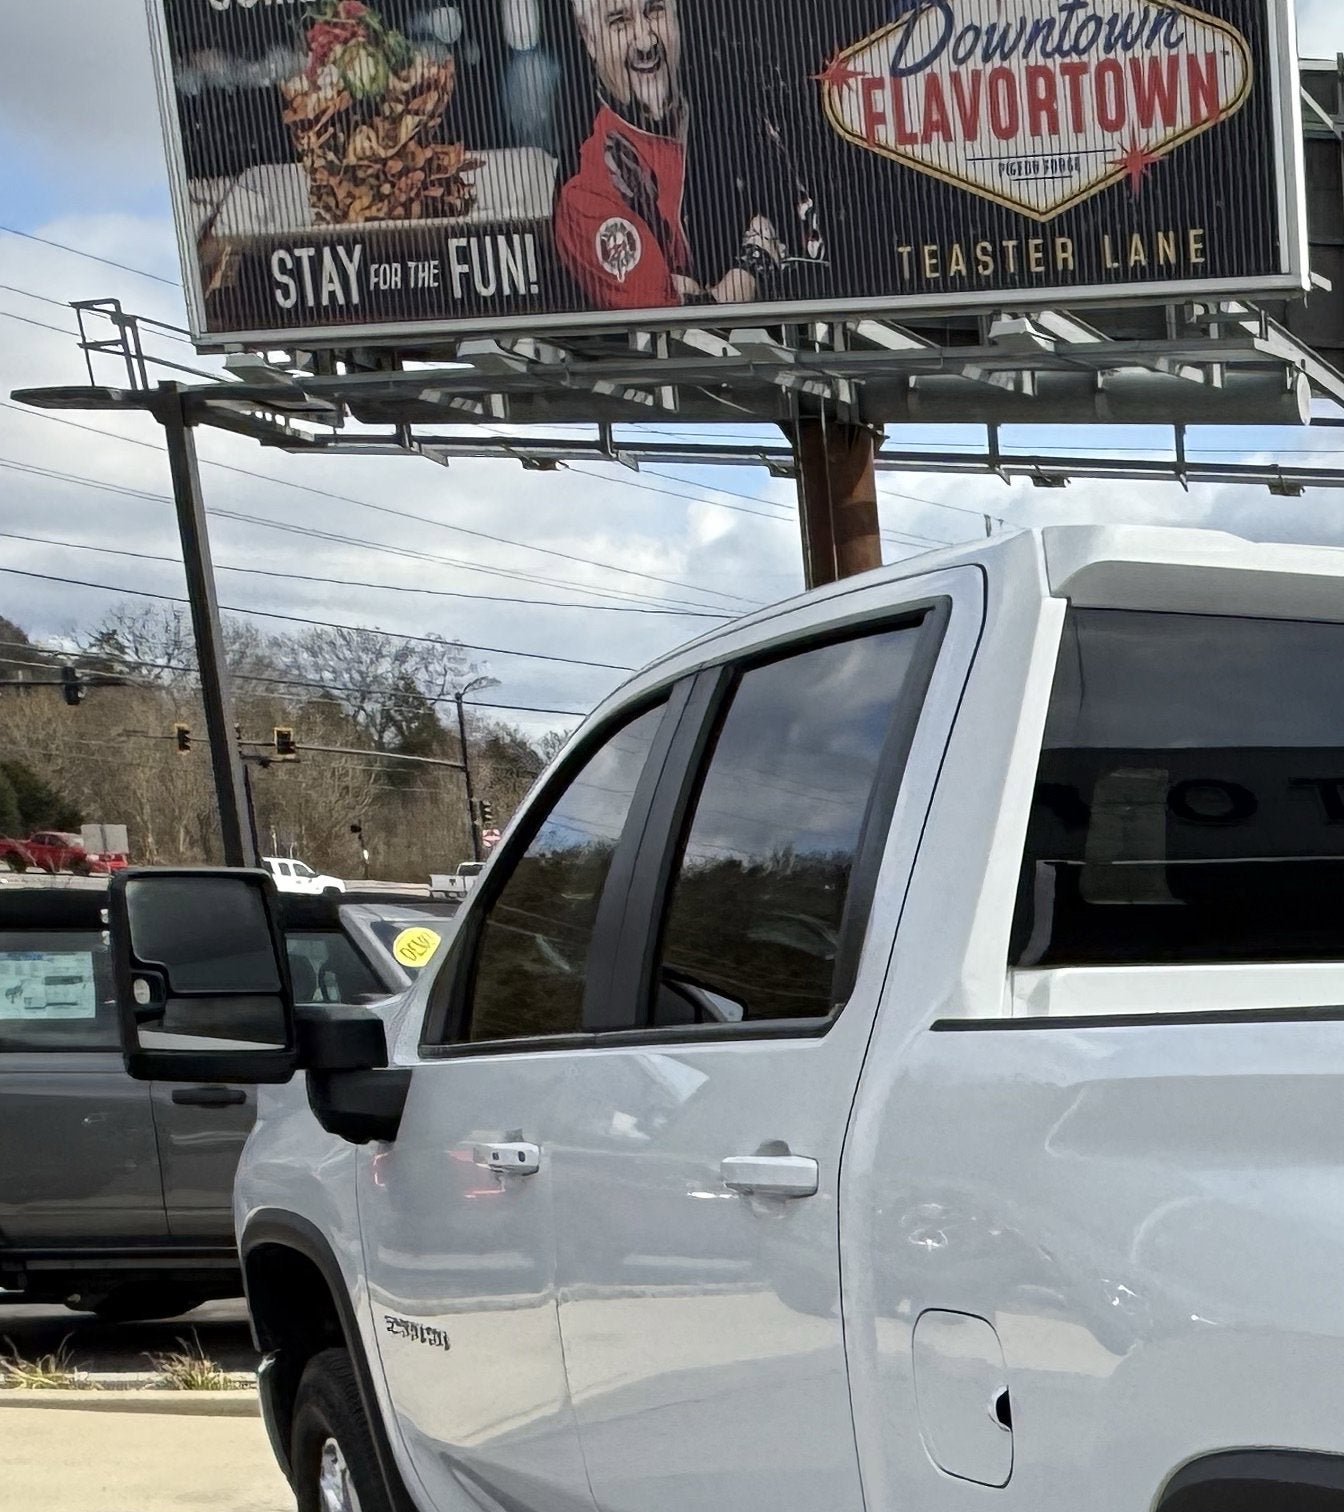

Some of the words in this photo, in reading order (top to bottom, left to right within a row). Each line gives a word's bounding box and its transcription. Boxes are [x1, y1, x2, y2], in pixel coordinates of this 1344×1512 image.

[891, 0, 1185, 77] Downtown
[861, 52, 1221, 147] FLAVORTOWN
[271, 243, 363, 309] STAY
[369, 263, 402, 291] FOR
[407, 259, 440, 288] THE
[448, 233, 540, 299] FUN!
[897, 237, 1075, 281] TEASTER
[1102, 228, 1206, 270] LANE
